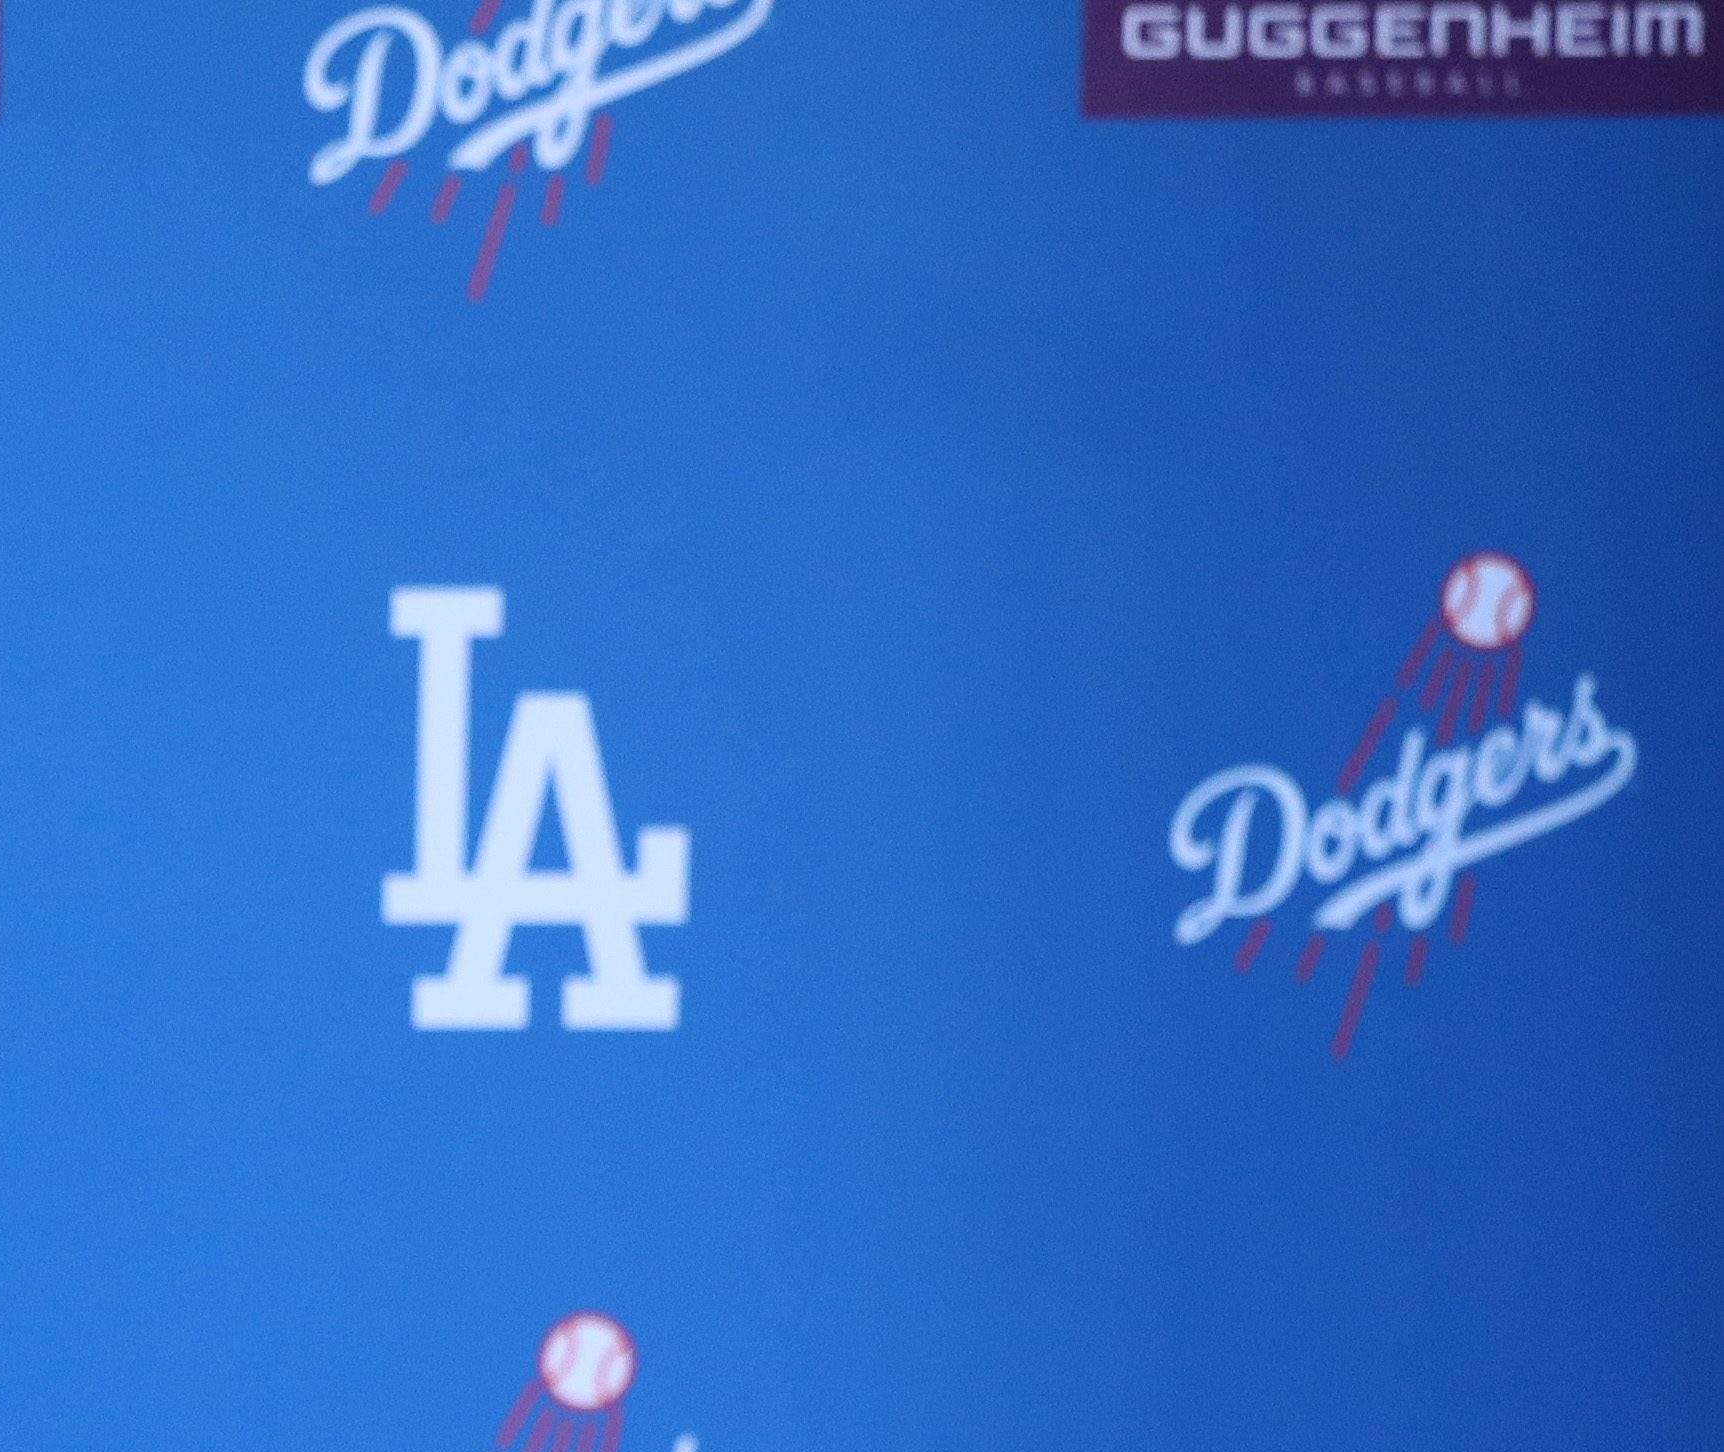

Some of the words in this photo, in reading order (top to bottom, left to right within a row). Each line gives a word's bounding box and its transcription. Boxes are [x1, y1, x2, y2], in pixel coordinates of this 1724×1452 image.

[302, 0, 773, 187] Dodge
[1121, 3, 1705, 61] GUGGENHEIM
[380, 586, 690, 1031] LA
[1169, 678, 1635, 945] Dodgers
